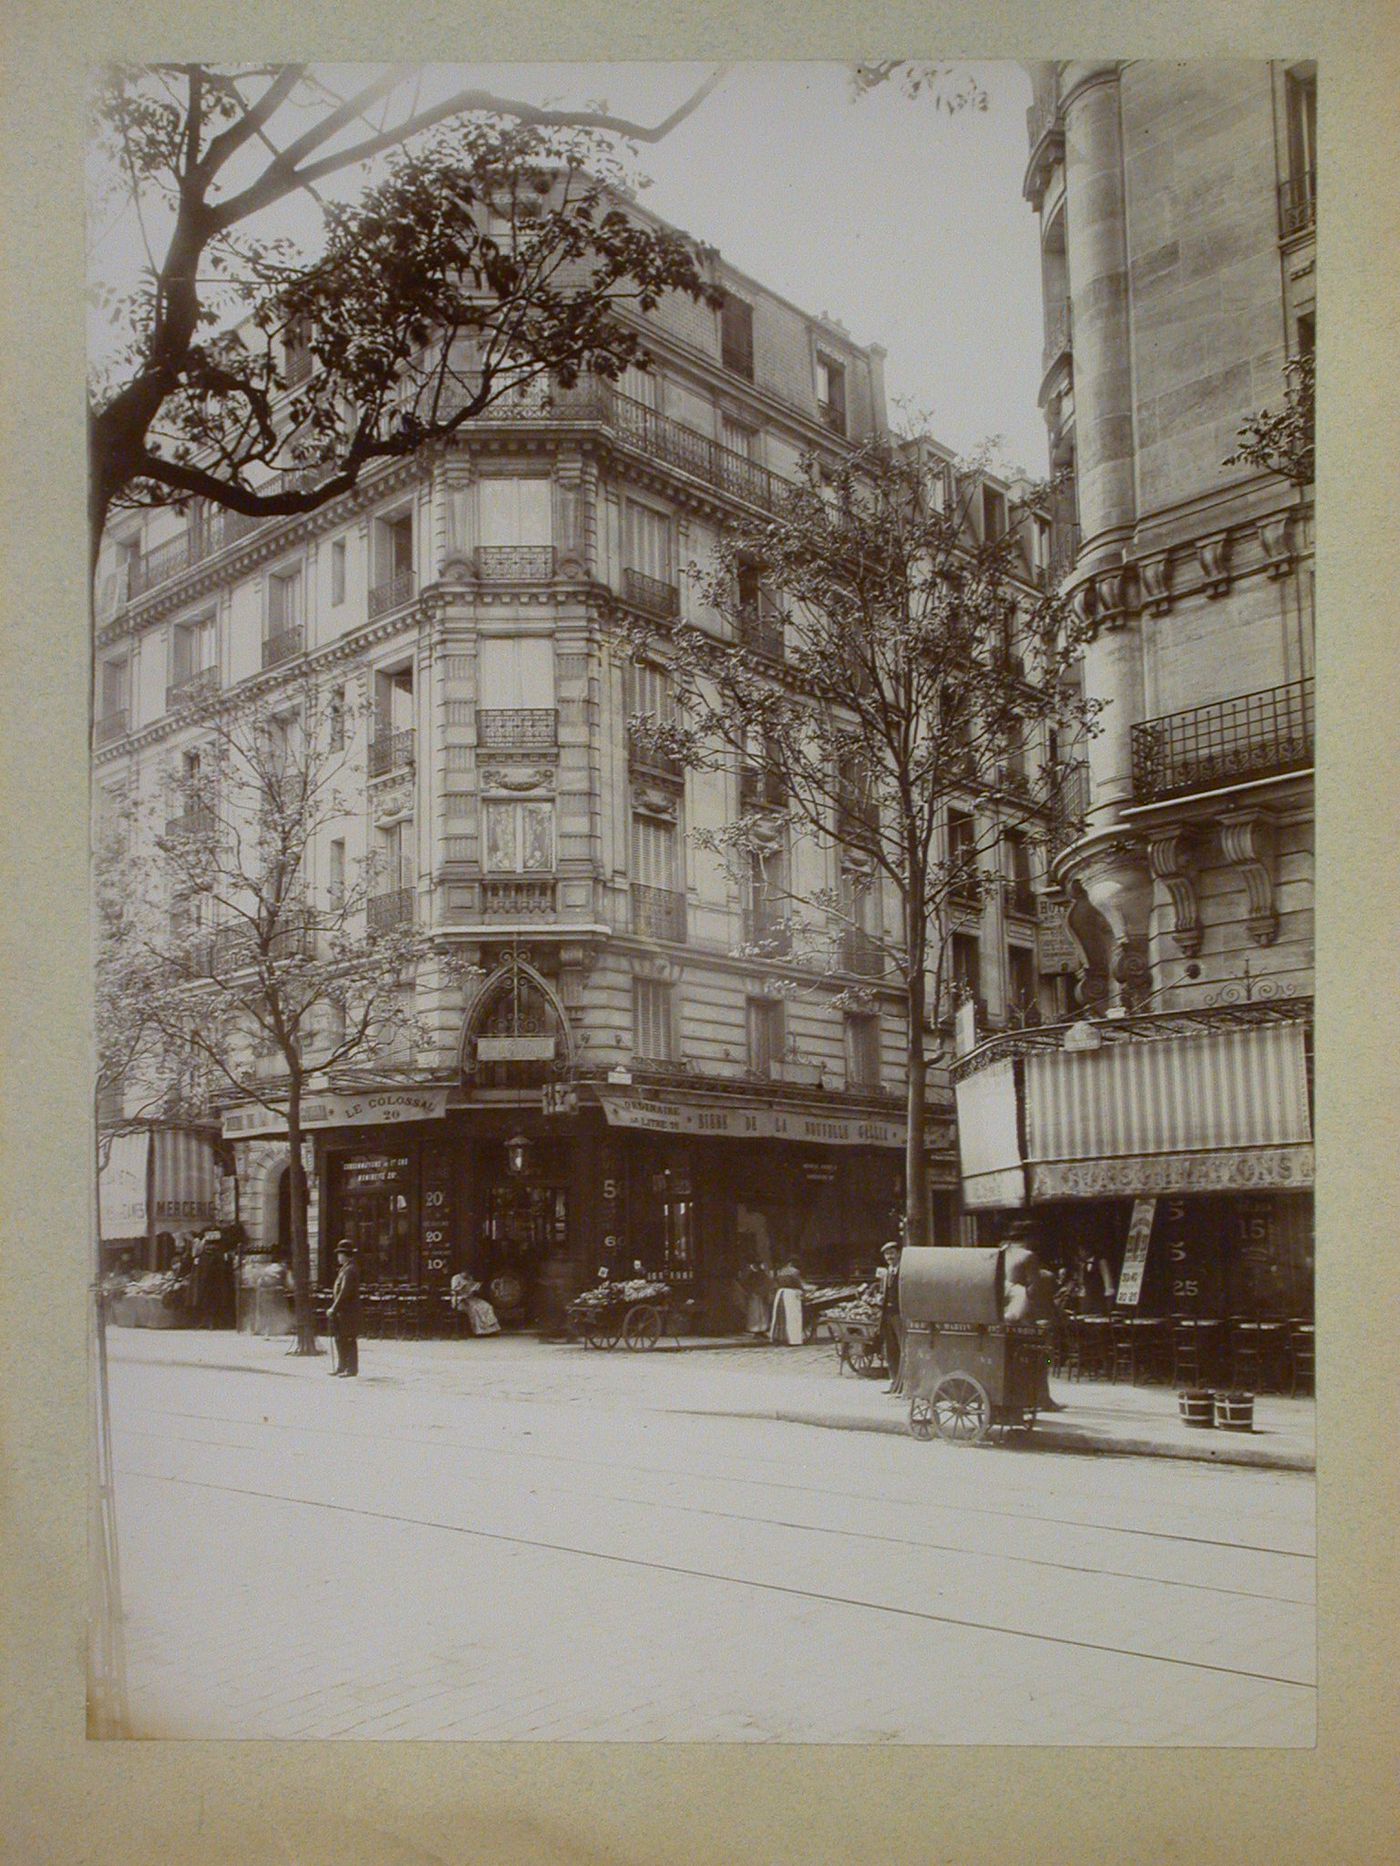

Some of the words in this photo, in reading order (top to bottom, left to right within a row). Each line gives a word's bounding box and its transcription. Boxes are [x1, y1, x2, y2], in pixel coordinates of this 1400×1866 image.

[345, 1104, 362, 1119] LE
[368, 1096, 436, 1112] COLOSSAL
[1173, 1280, 1198, 1296] 25
